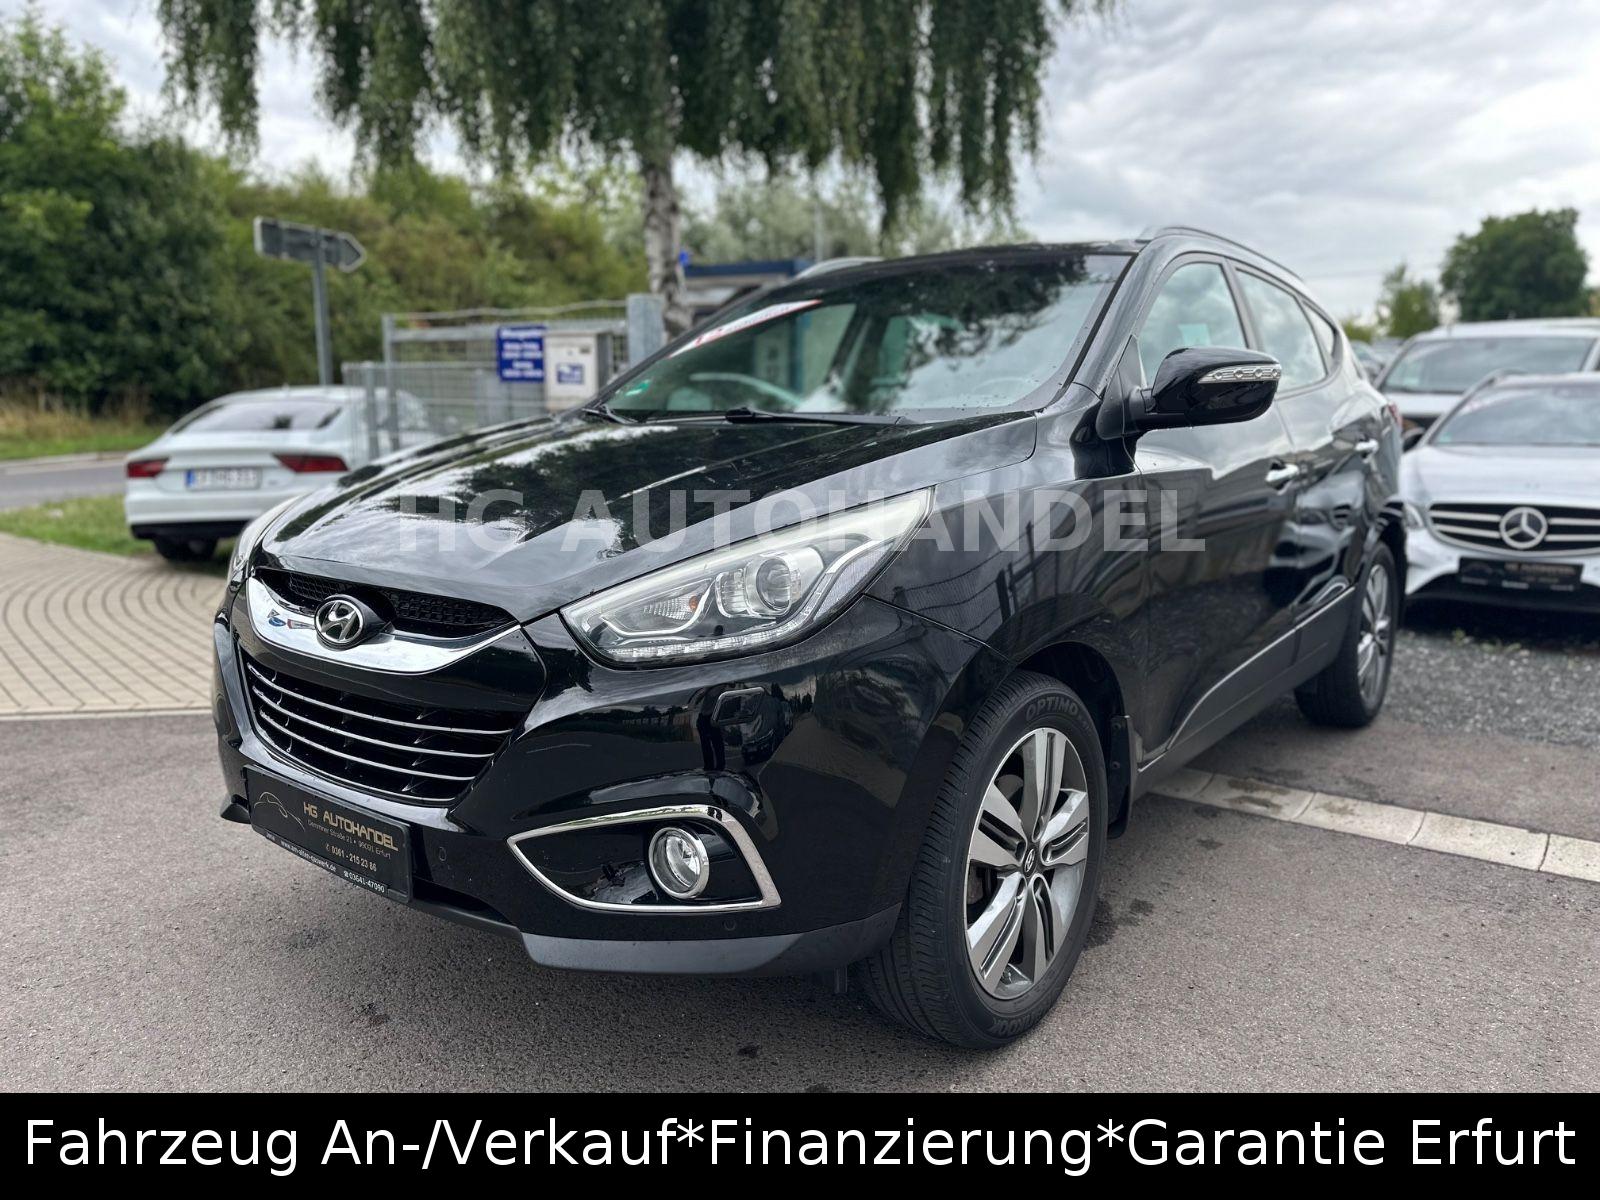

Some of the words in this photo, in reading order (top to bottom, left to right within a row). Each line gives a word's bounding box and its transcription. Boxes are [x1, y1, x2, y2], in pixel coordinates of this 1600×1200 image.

[1026, 696, 1079, 721] OPTIMO
[303, 801, 318, 819] HG
[323, 810, 399, 851] AUTOHANDEL
